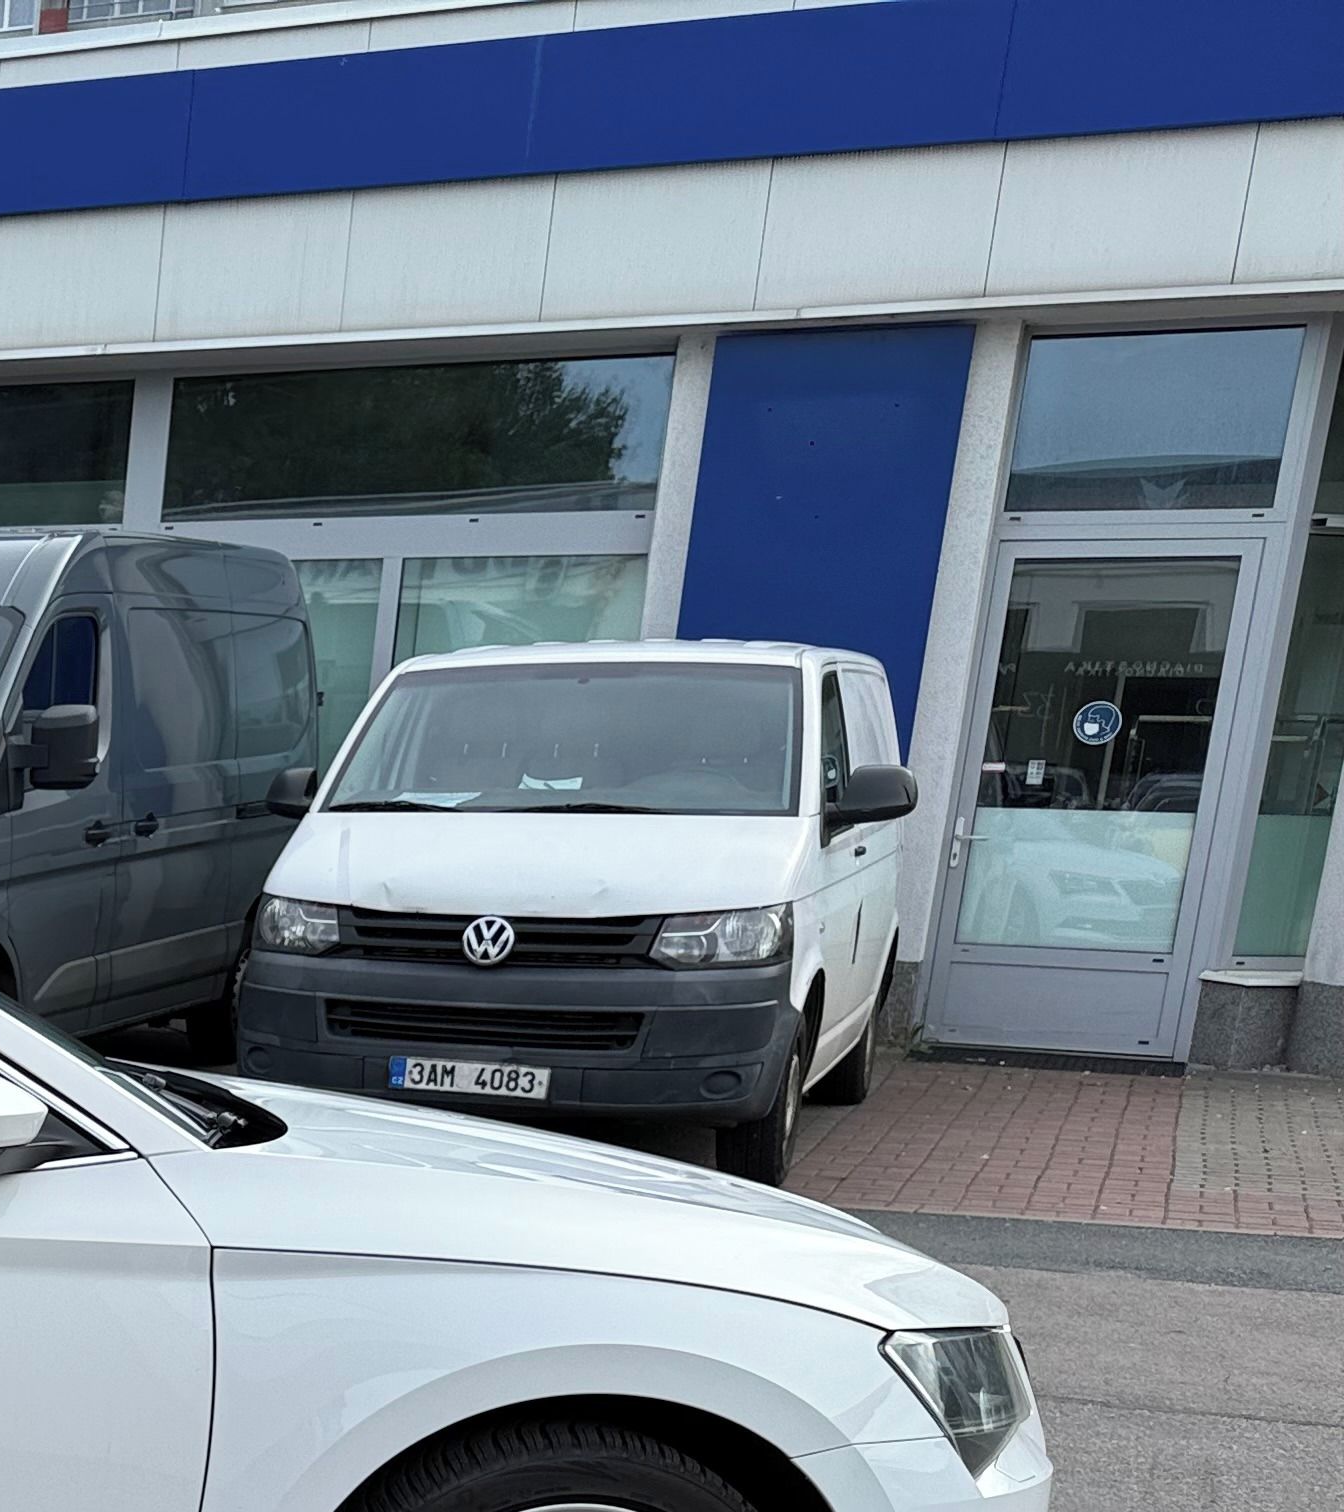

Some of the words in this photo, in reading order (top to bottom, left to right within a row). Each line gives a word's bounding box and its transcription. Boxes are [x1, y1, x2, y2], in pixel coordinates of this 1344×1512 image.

[391, 1076, 404, 1085] CZ
[410, 1062, 456, 1088] 3AM
[474, 1067, 537, 1094] 4083
